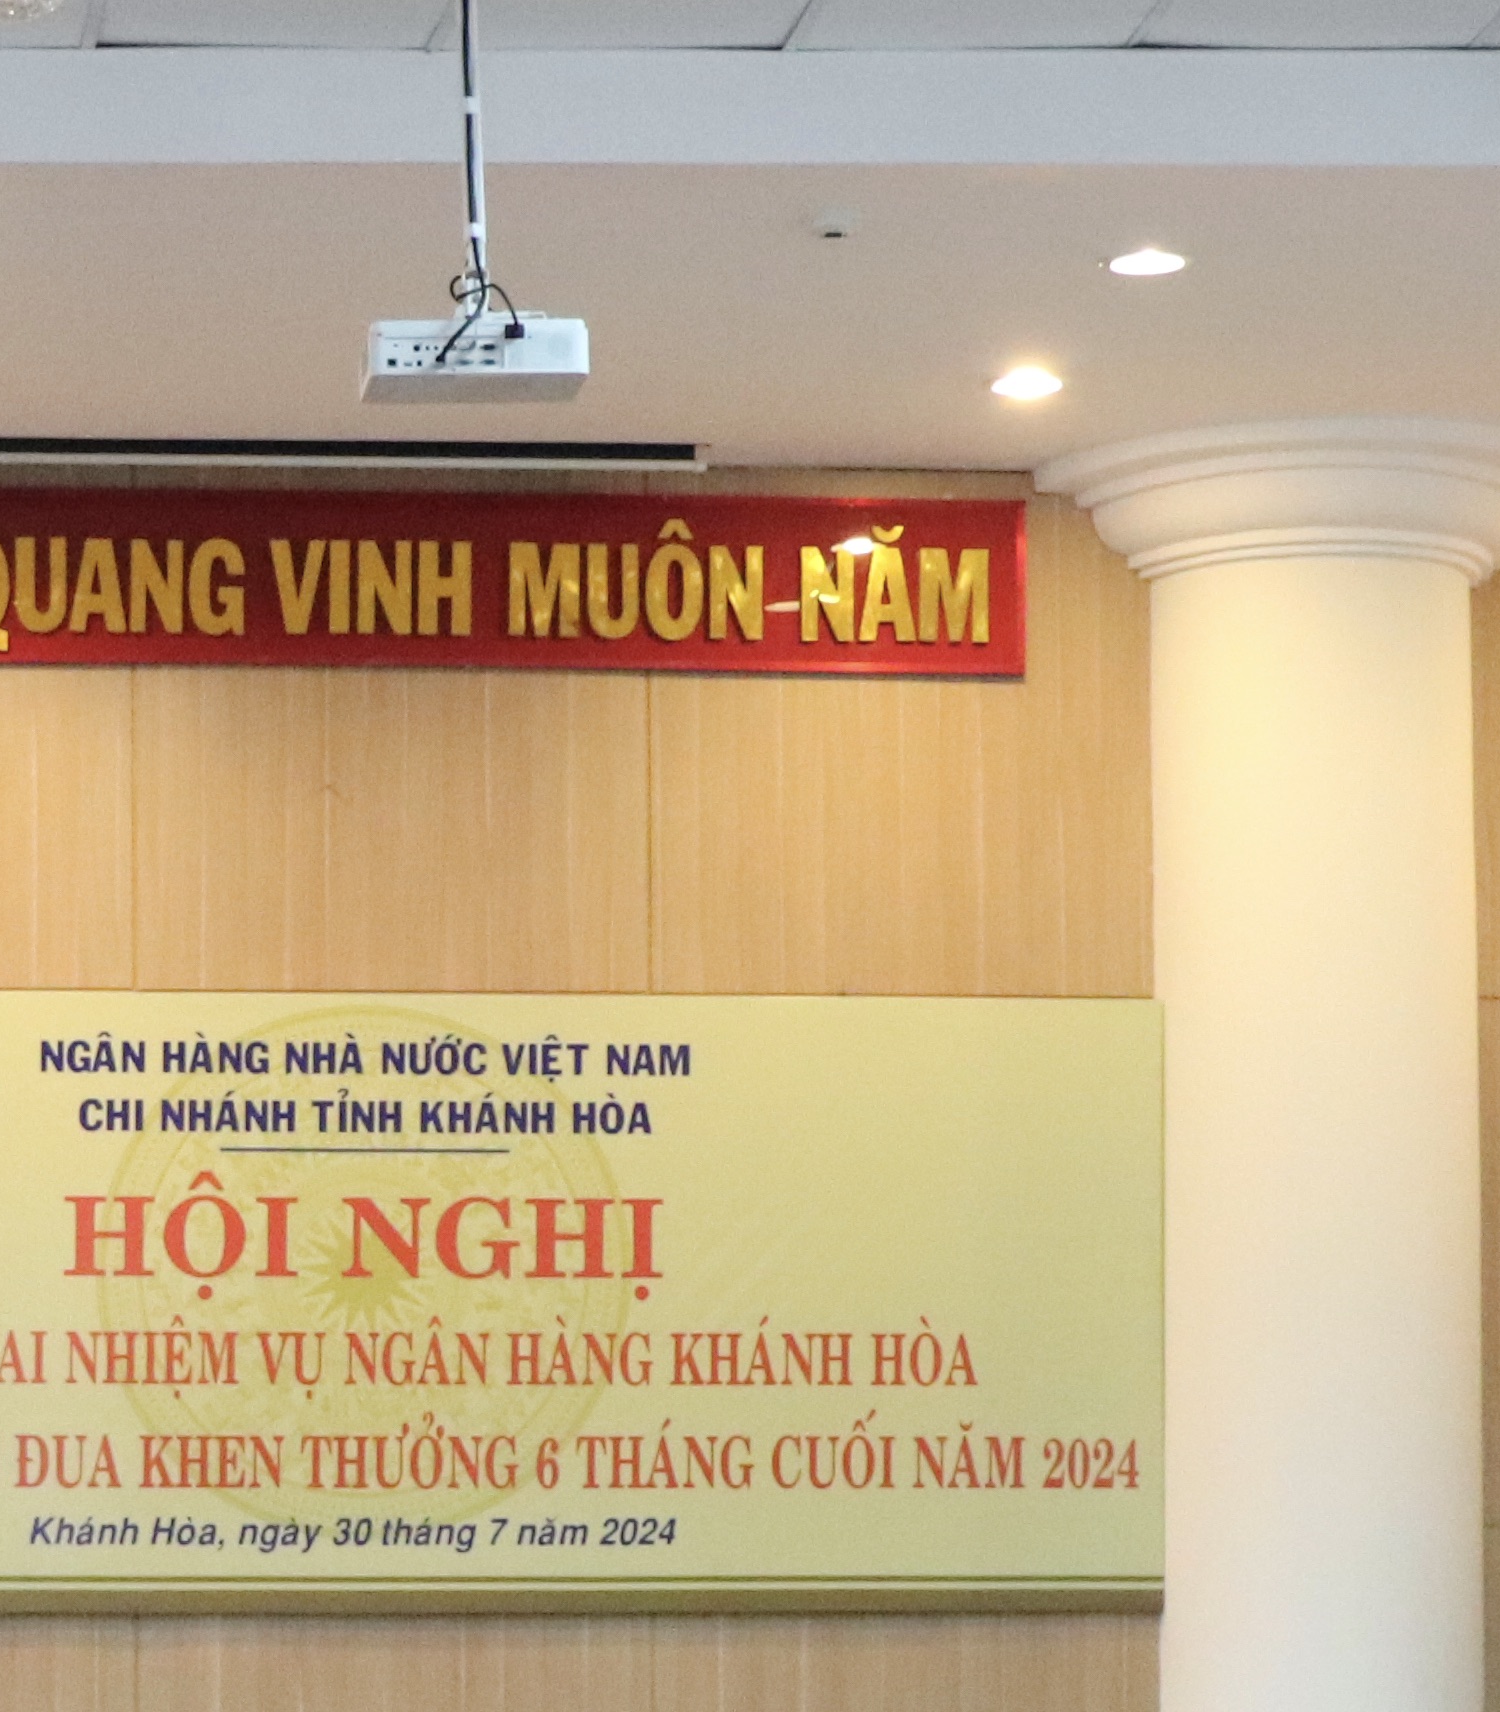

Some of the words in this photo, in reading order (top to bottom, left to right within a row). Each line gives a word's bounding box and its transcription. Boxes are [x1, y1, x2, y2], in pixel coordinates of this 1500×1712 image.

[271, 540, 471, 635] VINH
[509, 519, 763, 641] MUÔN
[795, 525, 990, 643] NĂM
[41, 1033, 145, 1073] NGÂN
[163, 1033, 269, 1074] HÀNG
[286, 1034, 362, 1074] NHÀ
[383, 1035, 486, 1075] NƯỚC
[503, 1035, 588, 1082] VIỆT
[607, 1045, 689, 1075] NAM
[80, 1099, 143, 1130] CHI
[162, 1091, 295, 1132] NHÁNH
[312, 1089, 401, 1132] TỈNH
[421, 1093, 554, 1133] KHÁNH
[573, 1094, 650, 1134] HÒA
[63, 1170, 298, 1299] HỘI
[342, 1196, 663, 1300] NGHỊ
[65, 1318, 239, 1399] NHIỆM
[256, 1331, 326, 1399] VỤ
[344, 1318, 490, 1385] NGÂN
[506, 1318, 652, 1385] HÀNG
[670, 1315, 852, 1385] KHÁNH
[871, 1316, 978, 1387] HÒA
[15, 1434, 121, 1488] ĐUA
[139, 1434, 284, 1488] KHEN
[300, 1412, 518, 1489] THƯỞNG
[535, 1436, 560, 1489] 6
[576, 1420, 754, 1489] THÁNG
[771, 1411, 896, 1489] CUỐI
[912, 1422, 1024, 1489] NĂM
[1042, 1438, 1140, 1489] 2024
[31, 1517, 138, 1544] Khánh
[152, 1518, 224, 1549] Hòa,
[239, 1519, 322, 1553] ngày
[334, 1518, 372, 1545] 30
[383, 1518, 476, 1552] tháng
[491, 1519, 507, 1545] 7
[518, 1519, 588, 1546] năm
[600, 1518, 675, 1545] 2024
